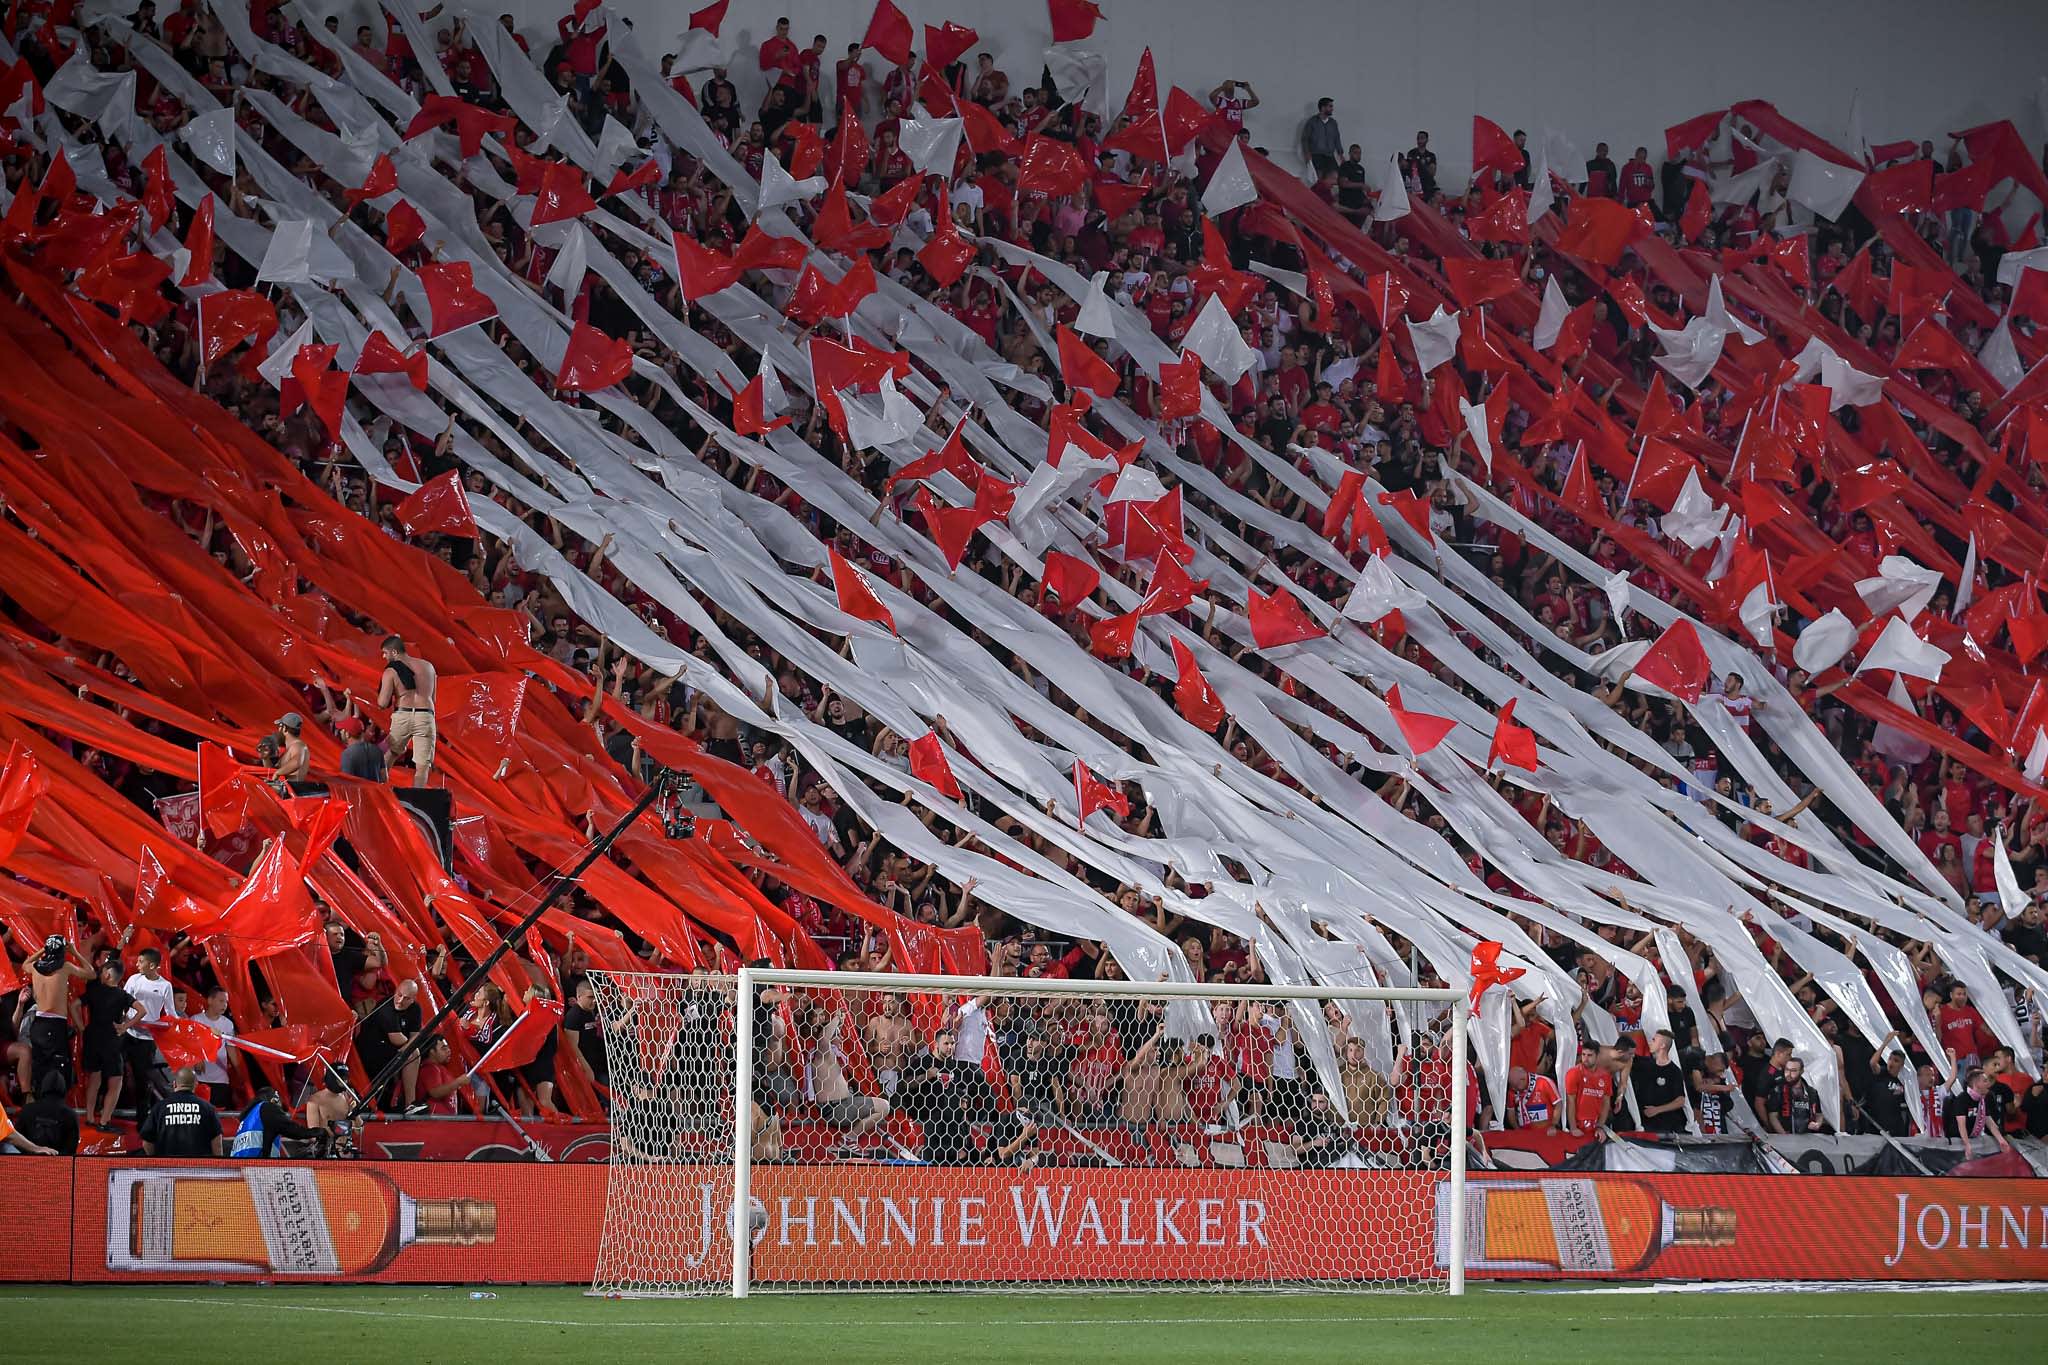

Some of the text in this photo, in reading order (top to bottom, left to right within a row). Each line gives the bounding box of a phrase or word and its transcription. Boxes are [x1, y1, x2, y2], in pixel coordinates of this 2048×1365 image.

[165, 1114, 202, 1126] אבטחה
[275, 1182, 307, 1269] RESERVE
[283, 1172, 318, 1271] GOLD LABEL
[1009, 1186, 1269, 1249] WALKER
[1565, 1191, 1588, 1268] RESERVE
[1570, 1183, 1598, 1269] GOLD LABEL
[1884, 1193, 2048, 1267] JOHN
